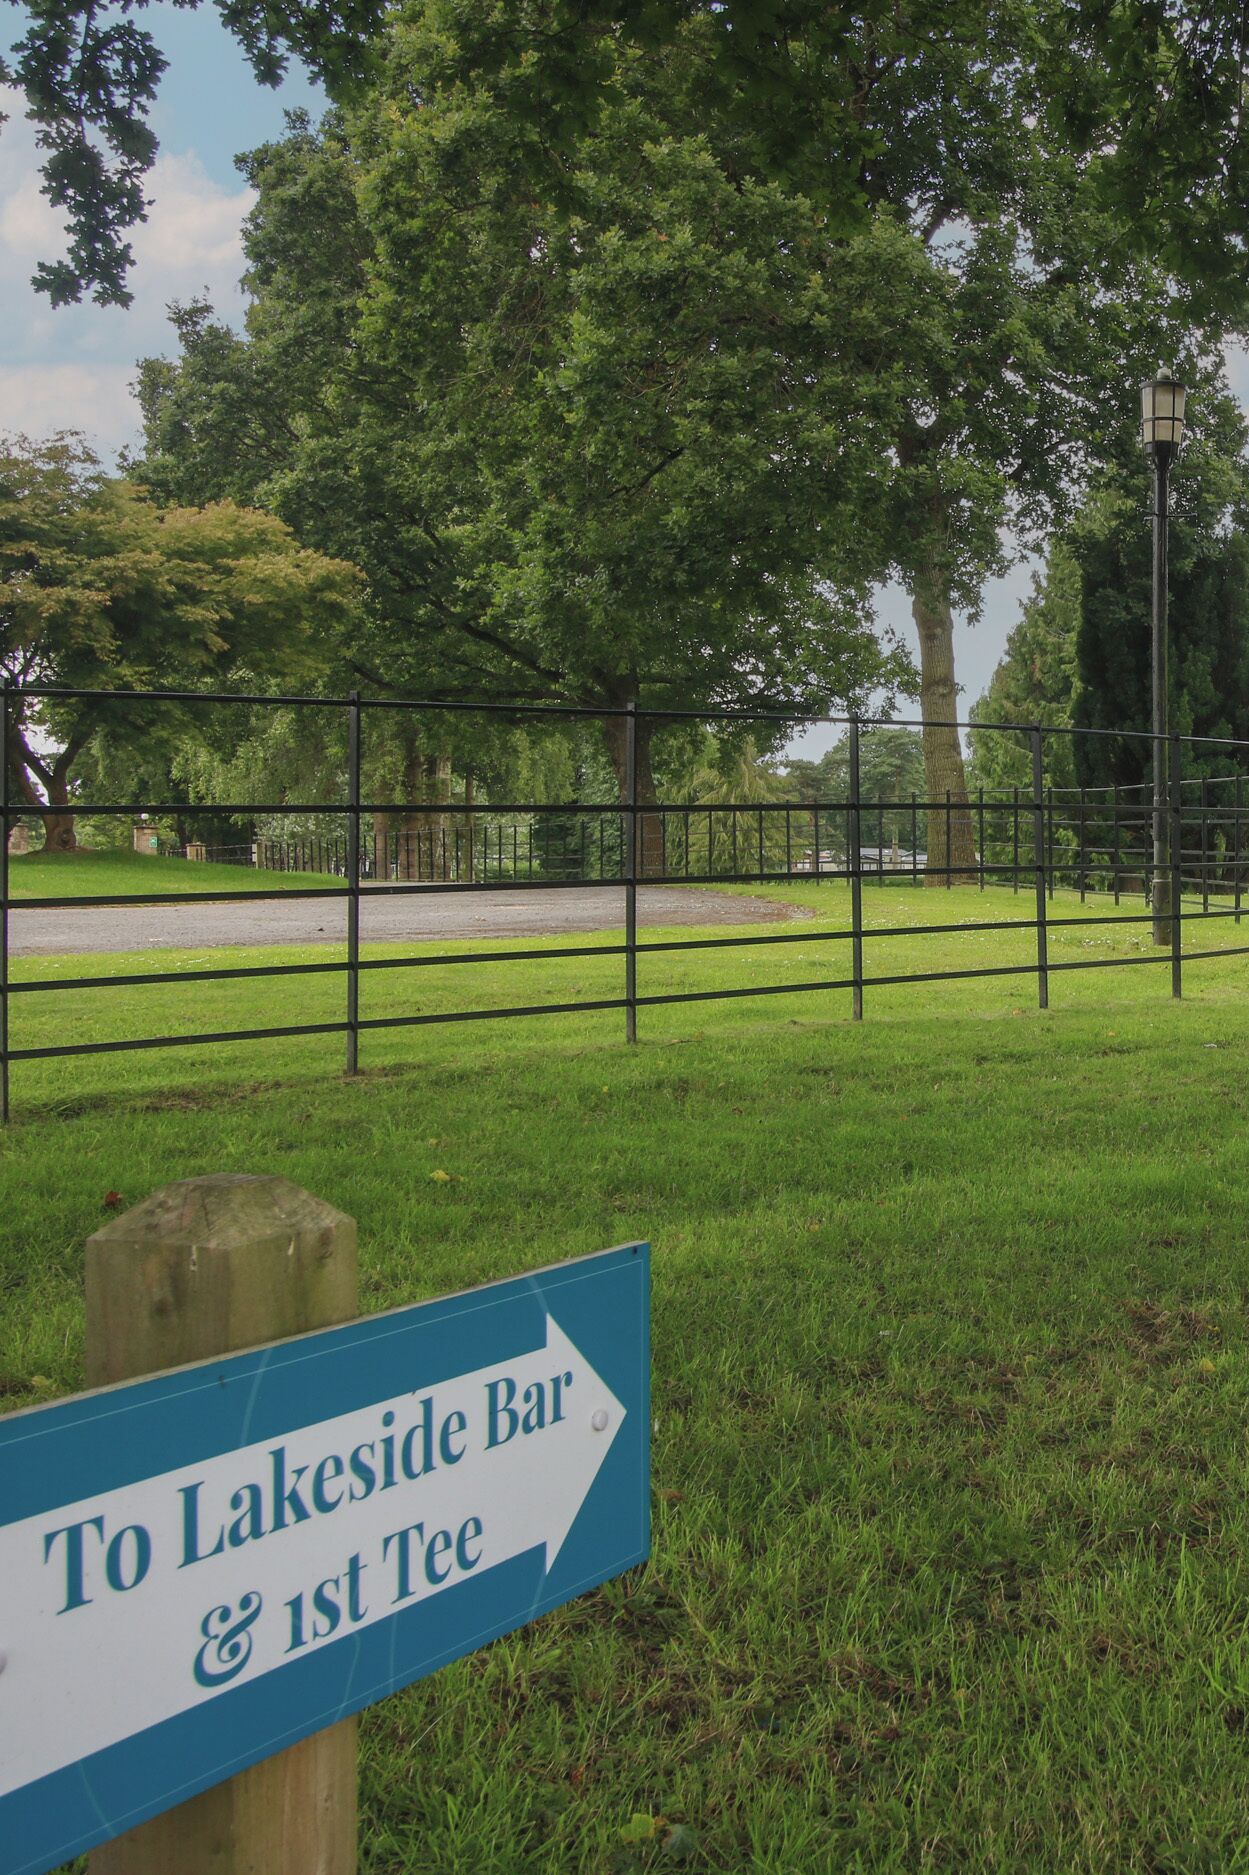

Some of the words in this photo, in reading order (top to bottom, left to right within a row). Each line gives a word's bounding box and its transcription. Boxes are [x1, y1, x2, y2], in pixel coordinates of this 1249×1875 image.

[44, 1515, 152, 1616] To
[178, 1396, 467, 1569] Lakeside
[485, 1370, 573, 1451] Bar
[193, 1591, 263, 1689] &
[284, 1552, 368, 1653] 1st
[382, 1516, 483, 1605] Tee
